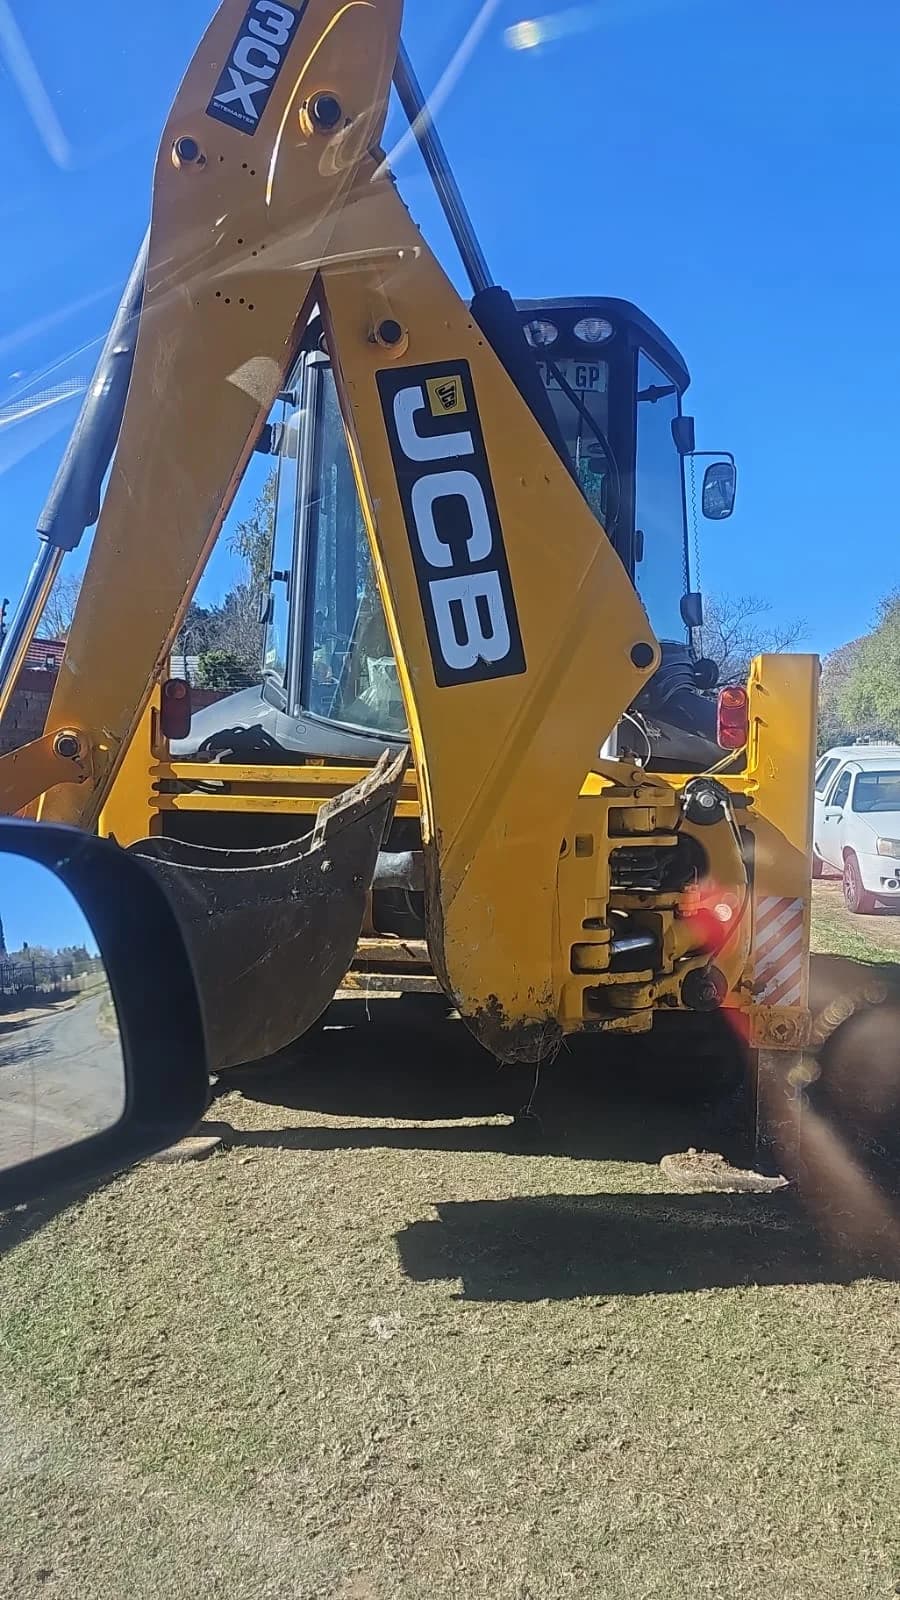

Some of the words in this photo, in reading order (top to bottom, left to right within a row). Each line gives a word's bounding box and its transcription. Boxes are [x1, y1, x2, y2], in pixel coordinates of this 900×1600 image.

[213, 0, 295, 119] 3CX
[213, 102, 255, 124] SITEMASTER
[575, 366, 600, 388] GP
[437, 385, 456, 408] JCB
[393, 385, 511, 669] JCB
